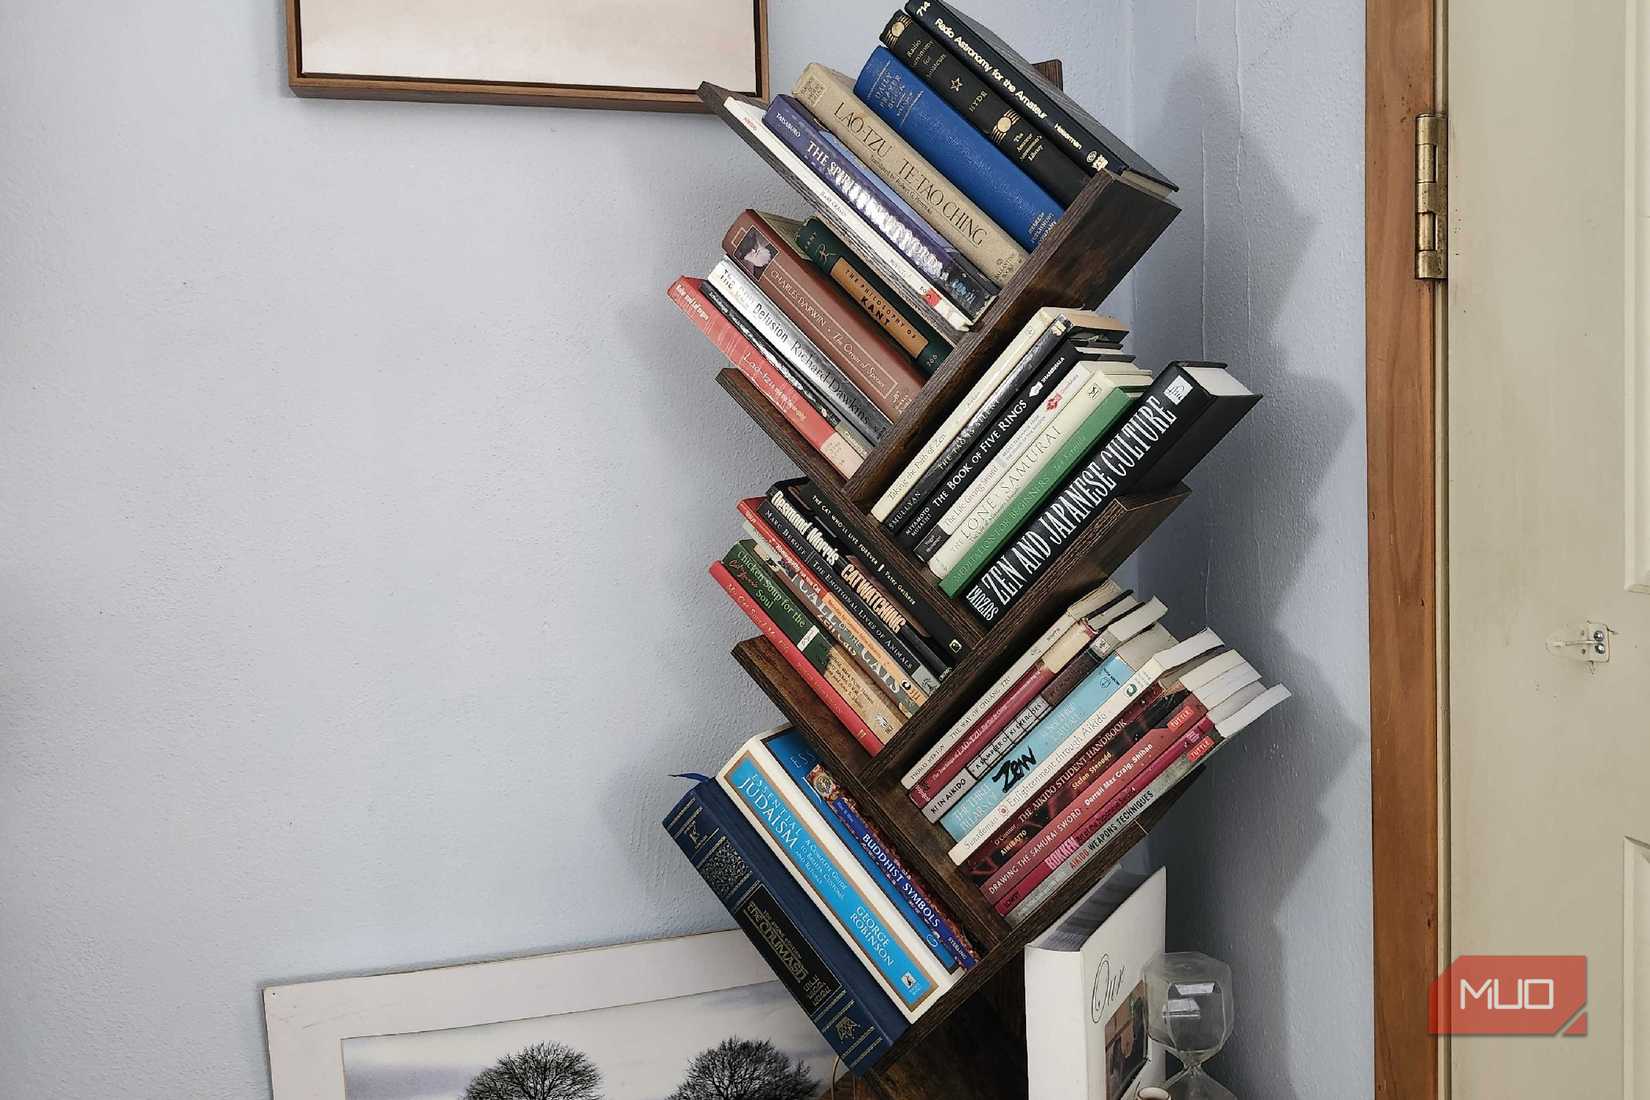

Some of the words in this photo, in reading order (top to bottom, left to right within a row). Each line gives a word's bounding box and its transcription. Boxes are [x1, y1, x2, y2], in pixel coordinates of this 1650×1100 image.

[934, 17, 956, 38] Radio
[952, 34, 994, 72] Astronomy
[991, 67, 1005, 81] for
[1002, 77, 1017, 92] the
[1014, 88, 1048, 119] Amateur
[965, 89, 989, 112] HYDE
[804, 140, 832, 166] THE
[1013, 130, 1024, 142] The
[1027, 143, 1043, 162] Library
[937, 199, 991, 246] CHING
[769, 267, 800, 301] CHARLES
[795, 294, 827, 328] DARWIN
[859, 283, 904, 328] PHILOSOPHY
[859, 295, 890, 327] KANT
[751, 302, 791, 343] Delusion
[789, 340, 830, 382] Richard
[826, 377, 873, 426] Dawkins
[904, 465, 918, 480] the
[913, 451, 929, 469] Path
[932, 489, 949, 507] THE
[945, 461, 973, 490] BOOK
[970, 450, 984, 464] OF
[978, 429, 1002, 453] FIVE
[996, 398, 1028, 432] RINGS
[959, 497, 998, 539] LONE
[999, 425, 1061, 493] SAMURAI
[810, 494, 822, 506] THE
[819, 504, 832, 516] CAT
[846, 532, 859, 545] LIVE
[856, 542, 878, 565] FOREVER
[887, 490, 922, 529] SMULLYAN
[904, 505, 931, 535] MIYAMOTO
[978, 554, 1029, 605] ZEN
[1006, 526, 1055, 575] AND
[1034, 460, 1117, 547] JAPANESE
[1096, 394, 1177, 479] CULTURE
[735, 549, 766, 581] Chicken
[760, 578, 784, 603] Soup
[780, 598, 796, 615] for
[790, 610, 807, 628] the
[768, 489, 813, 534] Desmond
[803, 526, 842, 566] Morris
[837, 561, 908, 633] CATWATCHING
[754, 588, 775, 610] Soul
[810, 559, 827, 576] THE
[823, 573, 860, 612] EMOTIONAL
[855, 608, 877, 631] LIVES
[873, 628, 886, 641] OF
[882, 638, 913, 670] ANIMALS
[964, 584, 1001, 621] SUZUKI
[796, 579, 840, 625] CALL
[857, 646, 902, 694] CATS
[949, 727, 962, 740] THE
[960, 715, 973, 728] WAY
[1170, 708, 1192, 728] TUTTLE
[1189, 737, 1213, 759] TUTTLE
[1005, 760, 1057, 808] Enlightenment
[1051, 733, 1084, 765] through
[1079, 710, 1108, 738] Aikido
[1017, 807, 1033, 823] THE
[1029, 784, 1057, 810] AIKIDO
[1054, 755, 1088, 787] STUDENT
[1084, 718, 1128, 758] HANDBOOK
[736, 776, 799, 850] JUDAISM
[750, 771, 803, 836] ESSENTIAL
[930, 804, 939, 813] KI
[936, 797, 946, 806] IN
[943, 777, 967, 799] AIKIDO
[986, 863, 1020, 895] DRAWING
[1016, 852, 1032, 868] THE
[1028, 828, 1059, 857] SAMURAI
[1055, 806, 1084, 832] SWORD
[1083, 786, 1106, 807] Darrell
[1103, 776, 1117, 789] Max
[1114, 760, 1135, 779] Craig,
[1130, 742, 1154, 764] Shihan
[998, 828, 1029, 856] AIKIBATTO
[1070, 769, 1093, 791] Stefan
[1043, 836, 1080, 870] BOKKEN
[1066, 848, 1090, 869] AIKIDO
[1086, 822, 1118, 852] WEAPONS
[1114, 789, 1154, 827] TECHNIQUES
[860, 834, 906, 883] BUDDHIST
[899, 882, 941, 927] SYMBOLS
[849, 911, 894, 966] ROBINSON
[854, 905, 890, 947] GEORGE
[1090, 953, 1126, 1024] Our
